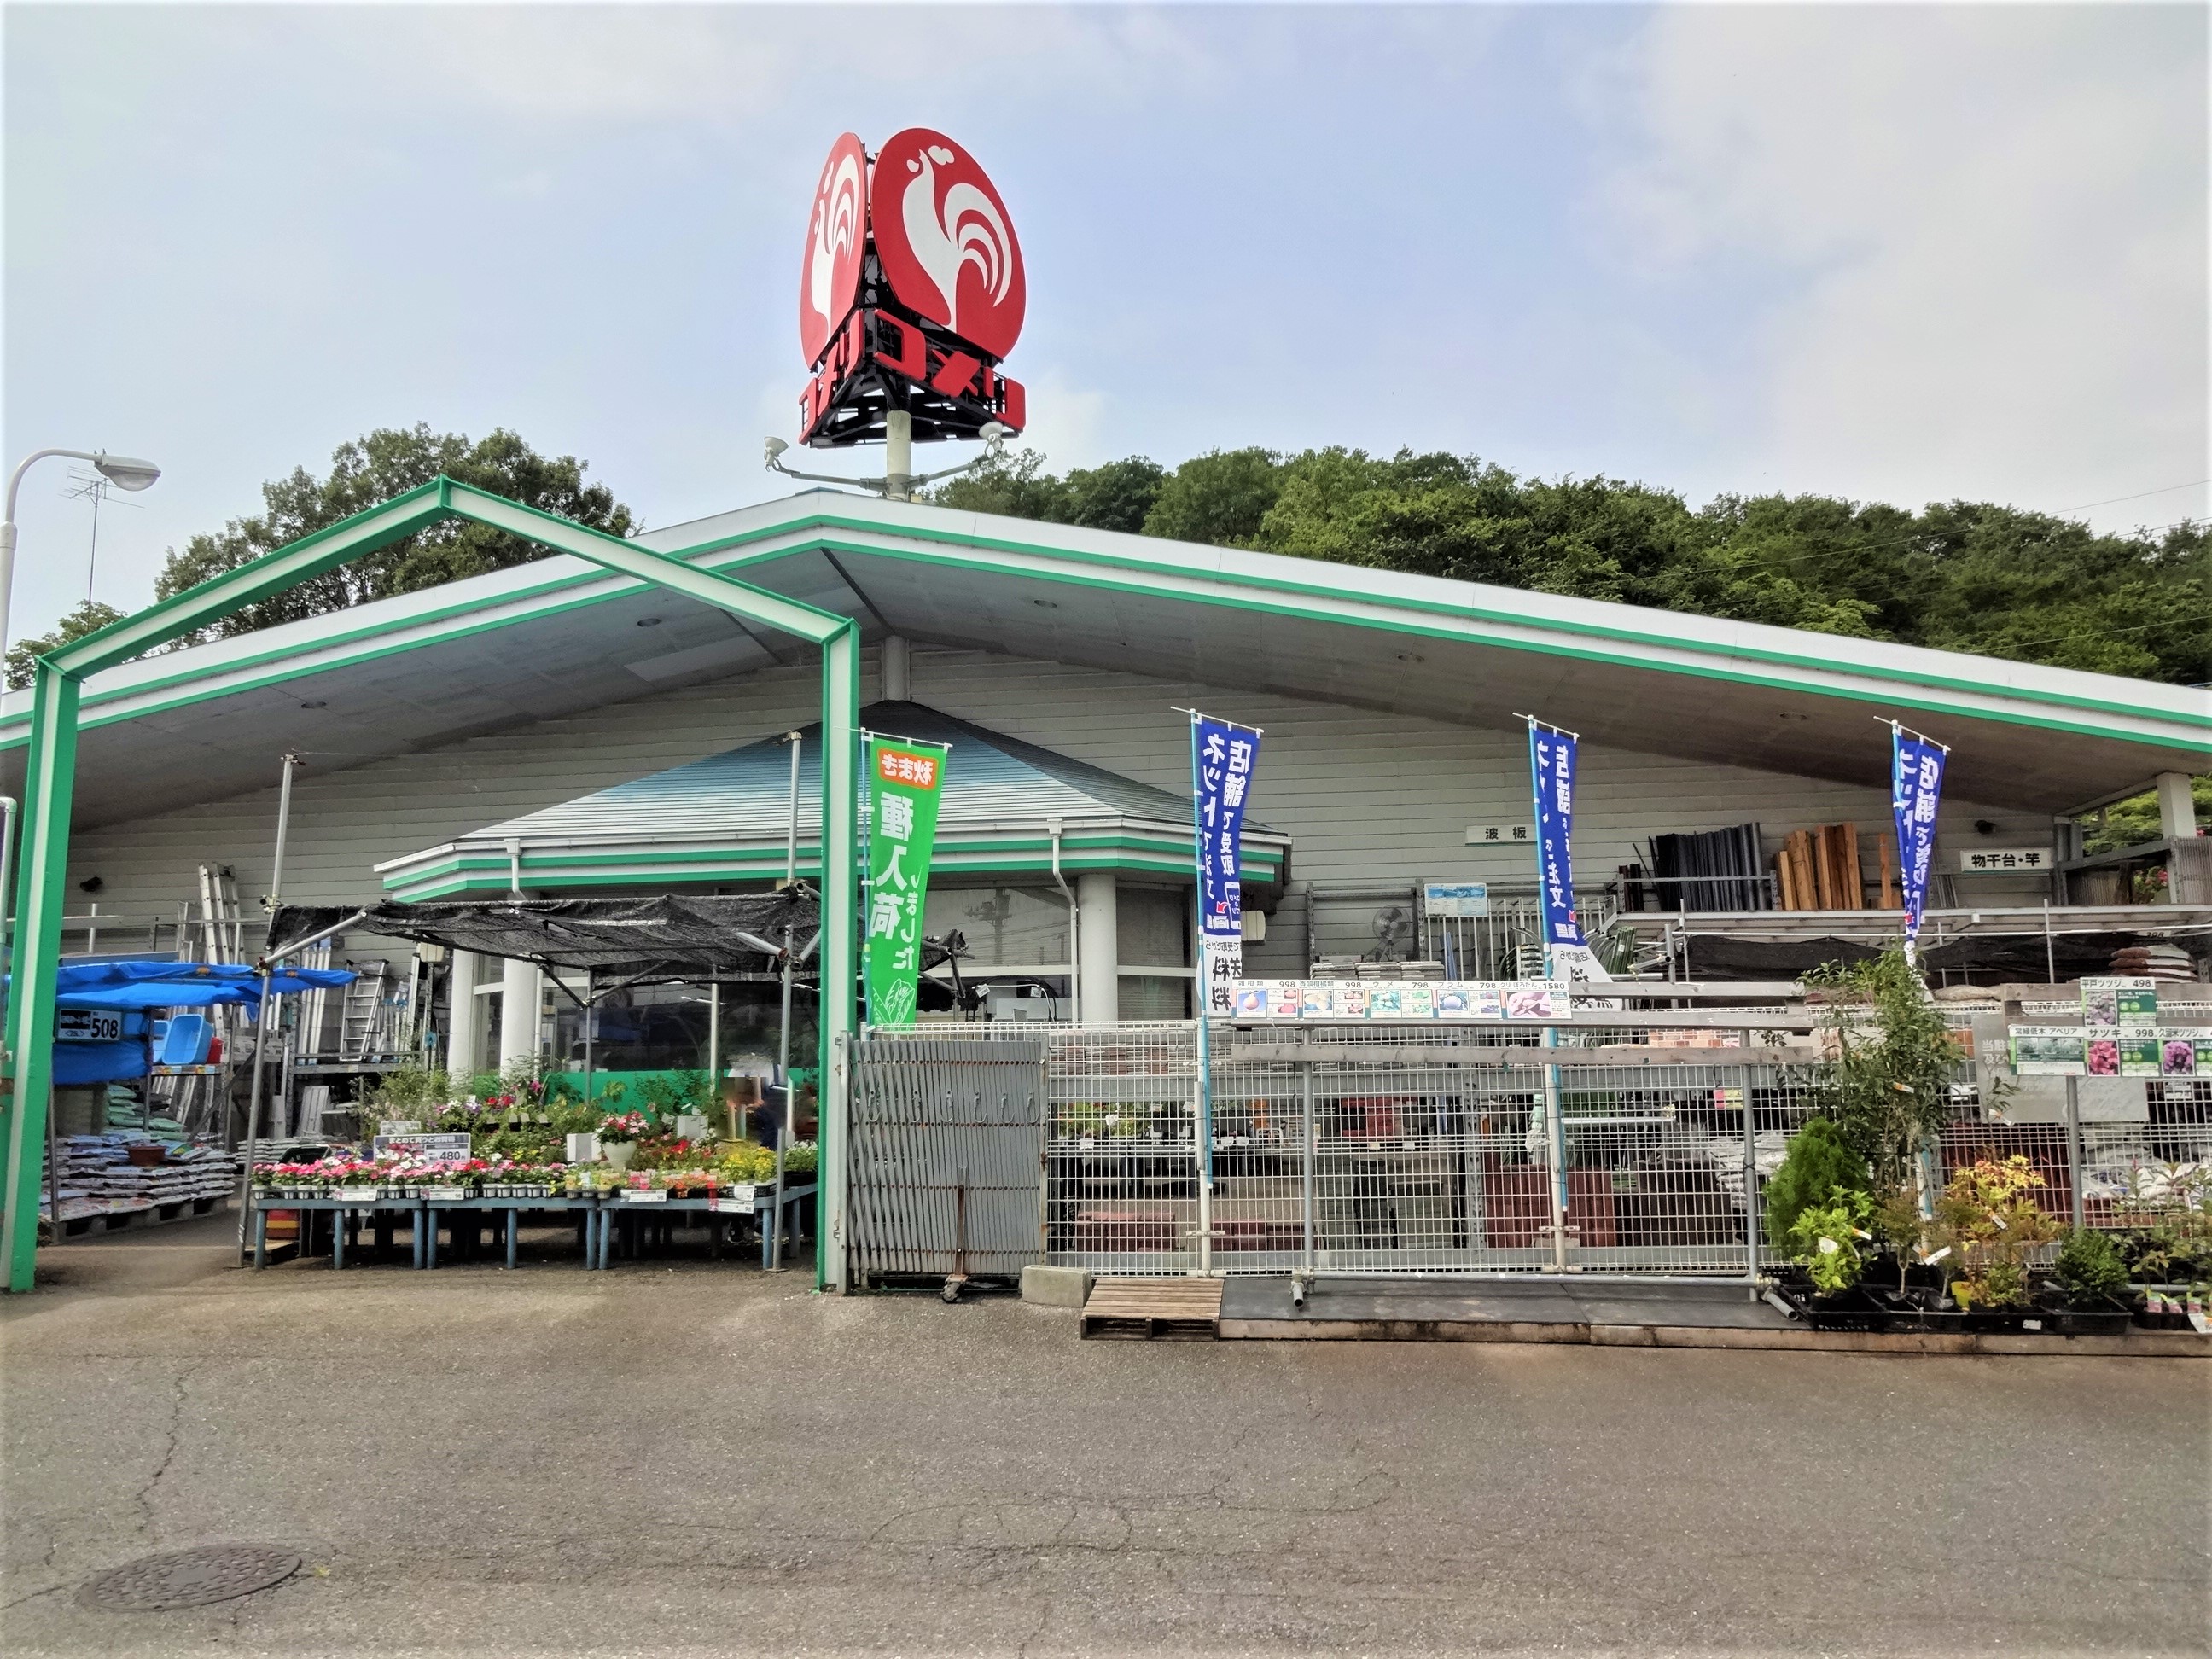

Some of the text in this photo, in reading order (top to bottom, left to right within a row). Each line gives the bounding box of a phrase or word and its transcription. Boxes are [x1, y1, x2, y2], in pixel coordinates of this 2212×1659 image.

[873, 308, 1026, 430] コメリ
[1485, 826, 1527, 840] 波板
[1971, 853, 2040, 868] 物干台・竿
[2081, 978, 2151, 988] 平戸ツツジ 498
[90, 1017, 119, 1039] 508
[2089, 1028, 2154, 1038] サツキ 998
[1982, 1039, 2011, 1051] 当駐
[439, 1150, 461, 1161] 480
